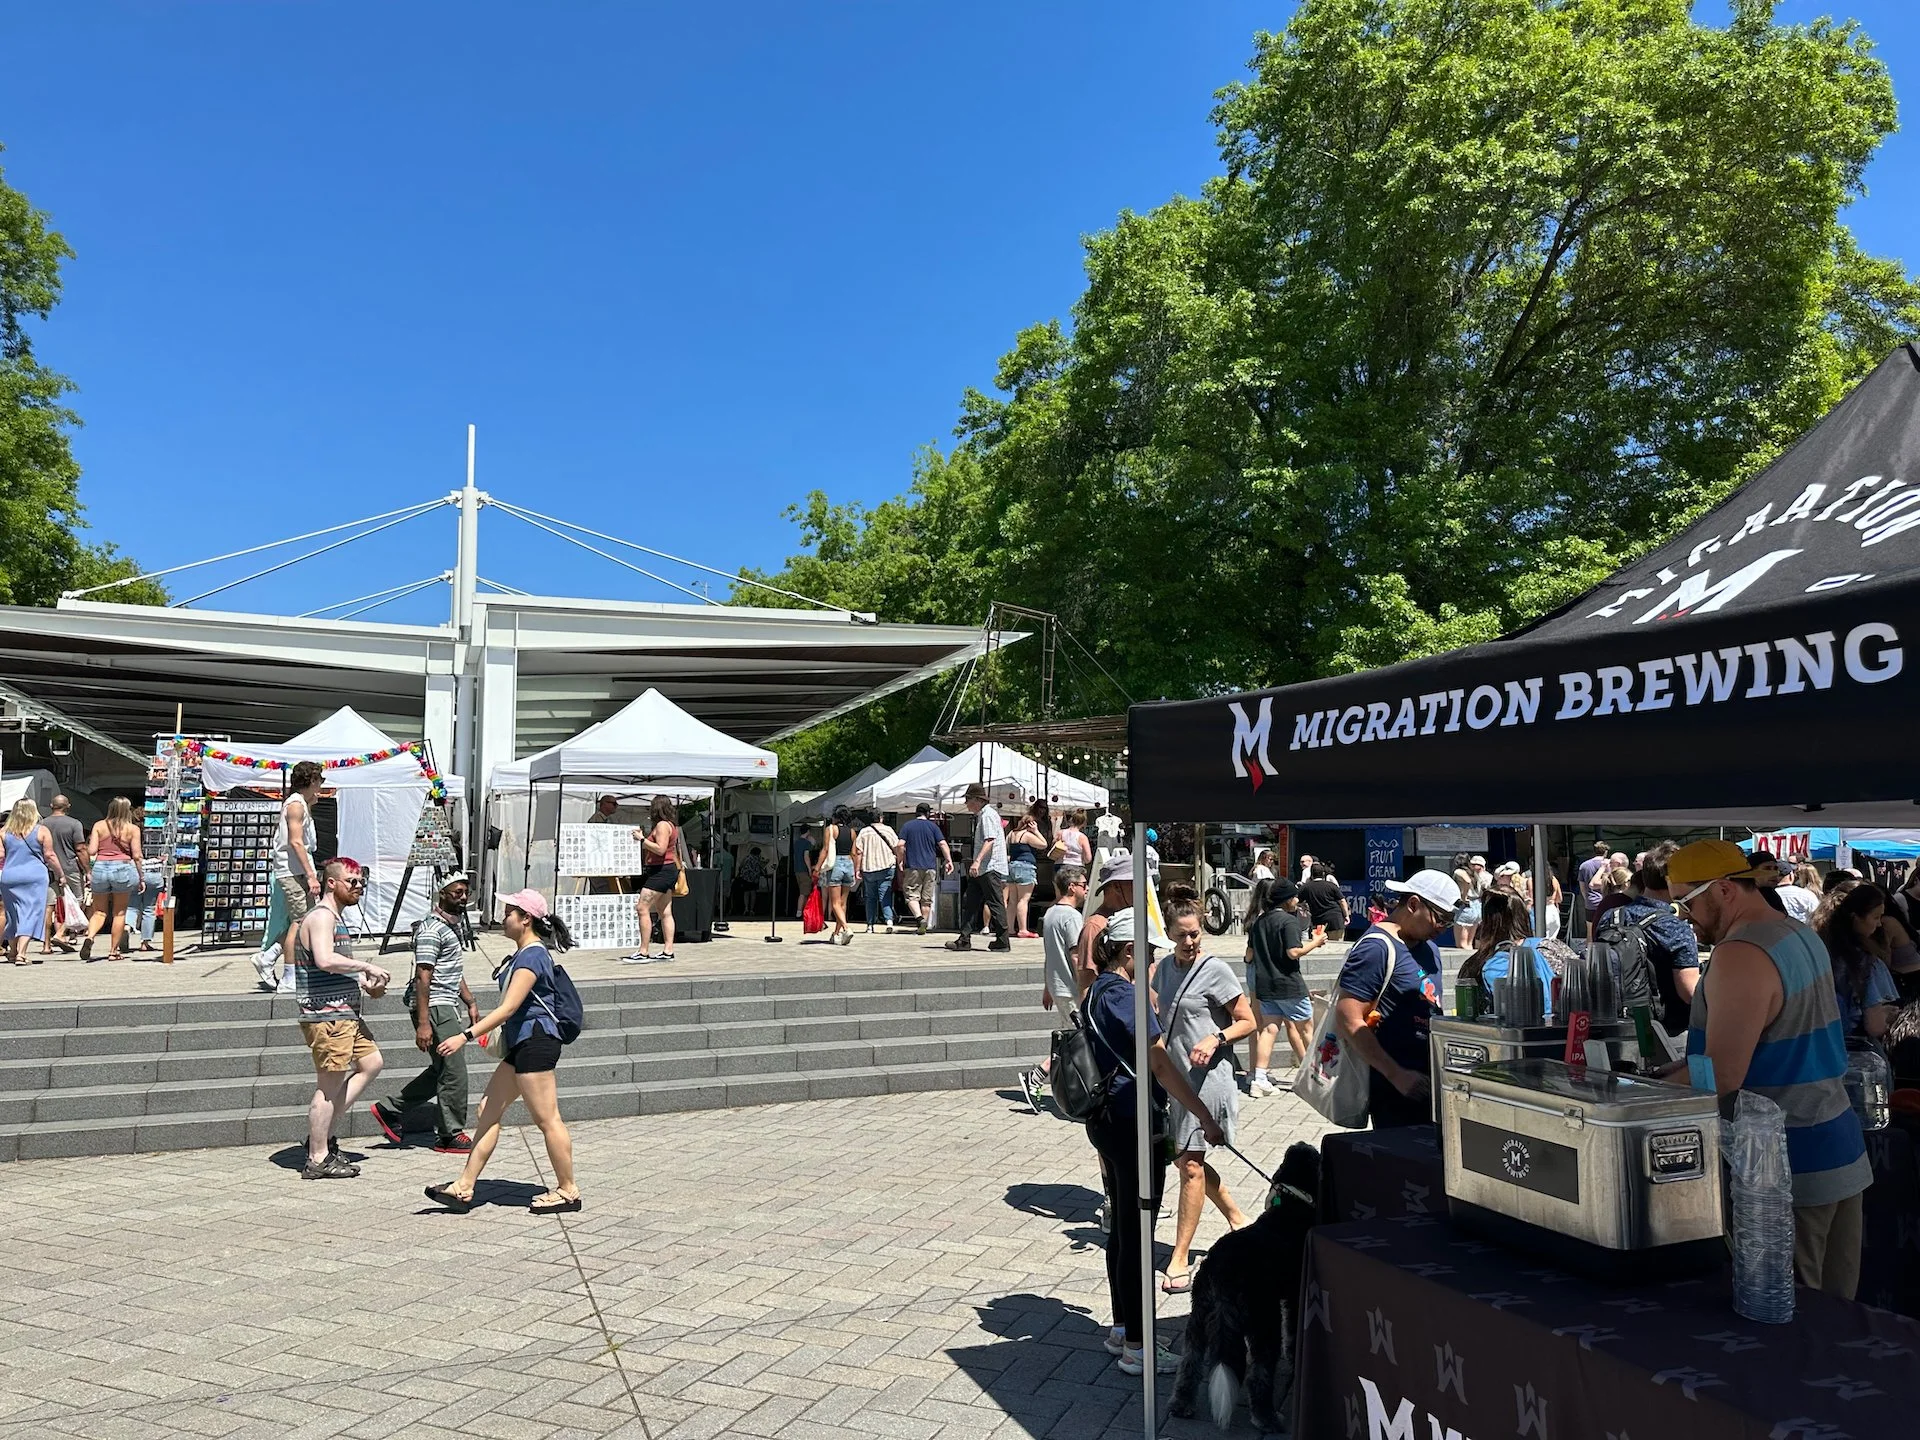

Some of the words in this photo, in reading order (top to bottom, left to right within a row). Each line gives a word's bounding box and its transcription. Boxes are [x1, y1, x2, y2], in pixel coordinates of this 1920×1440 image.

[1289, 678, 1544, 751] MIGRATION
[1555, 622, 1904, 721] BREWING
[223, 802, 239, 811] PDX
[1758, 834, 1809, 860] ATM
[1370, 849, 1395, 864] FRUIT
[1368, 865, 1396, 878] CREAM
[1369, 879, 1395, 893] SOD
[1571, 1053, 1585, 1061] IPA
[1502, 1139, 1530, 1159] MIGRATION
[1511, 1150, 1521, 1167] M
